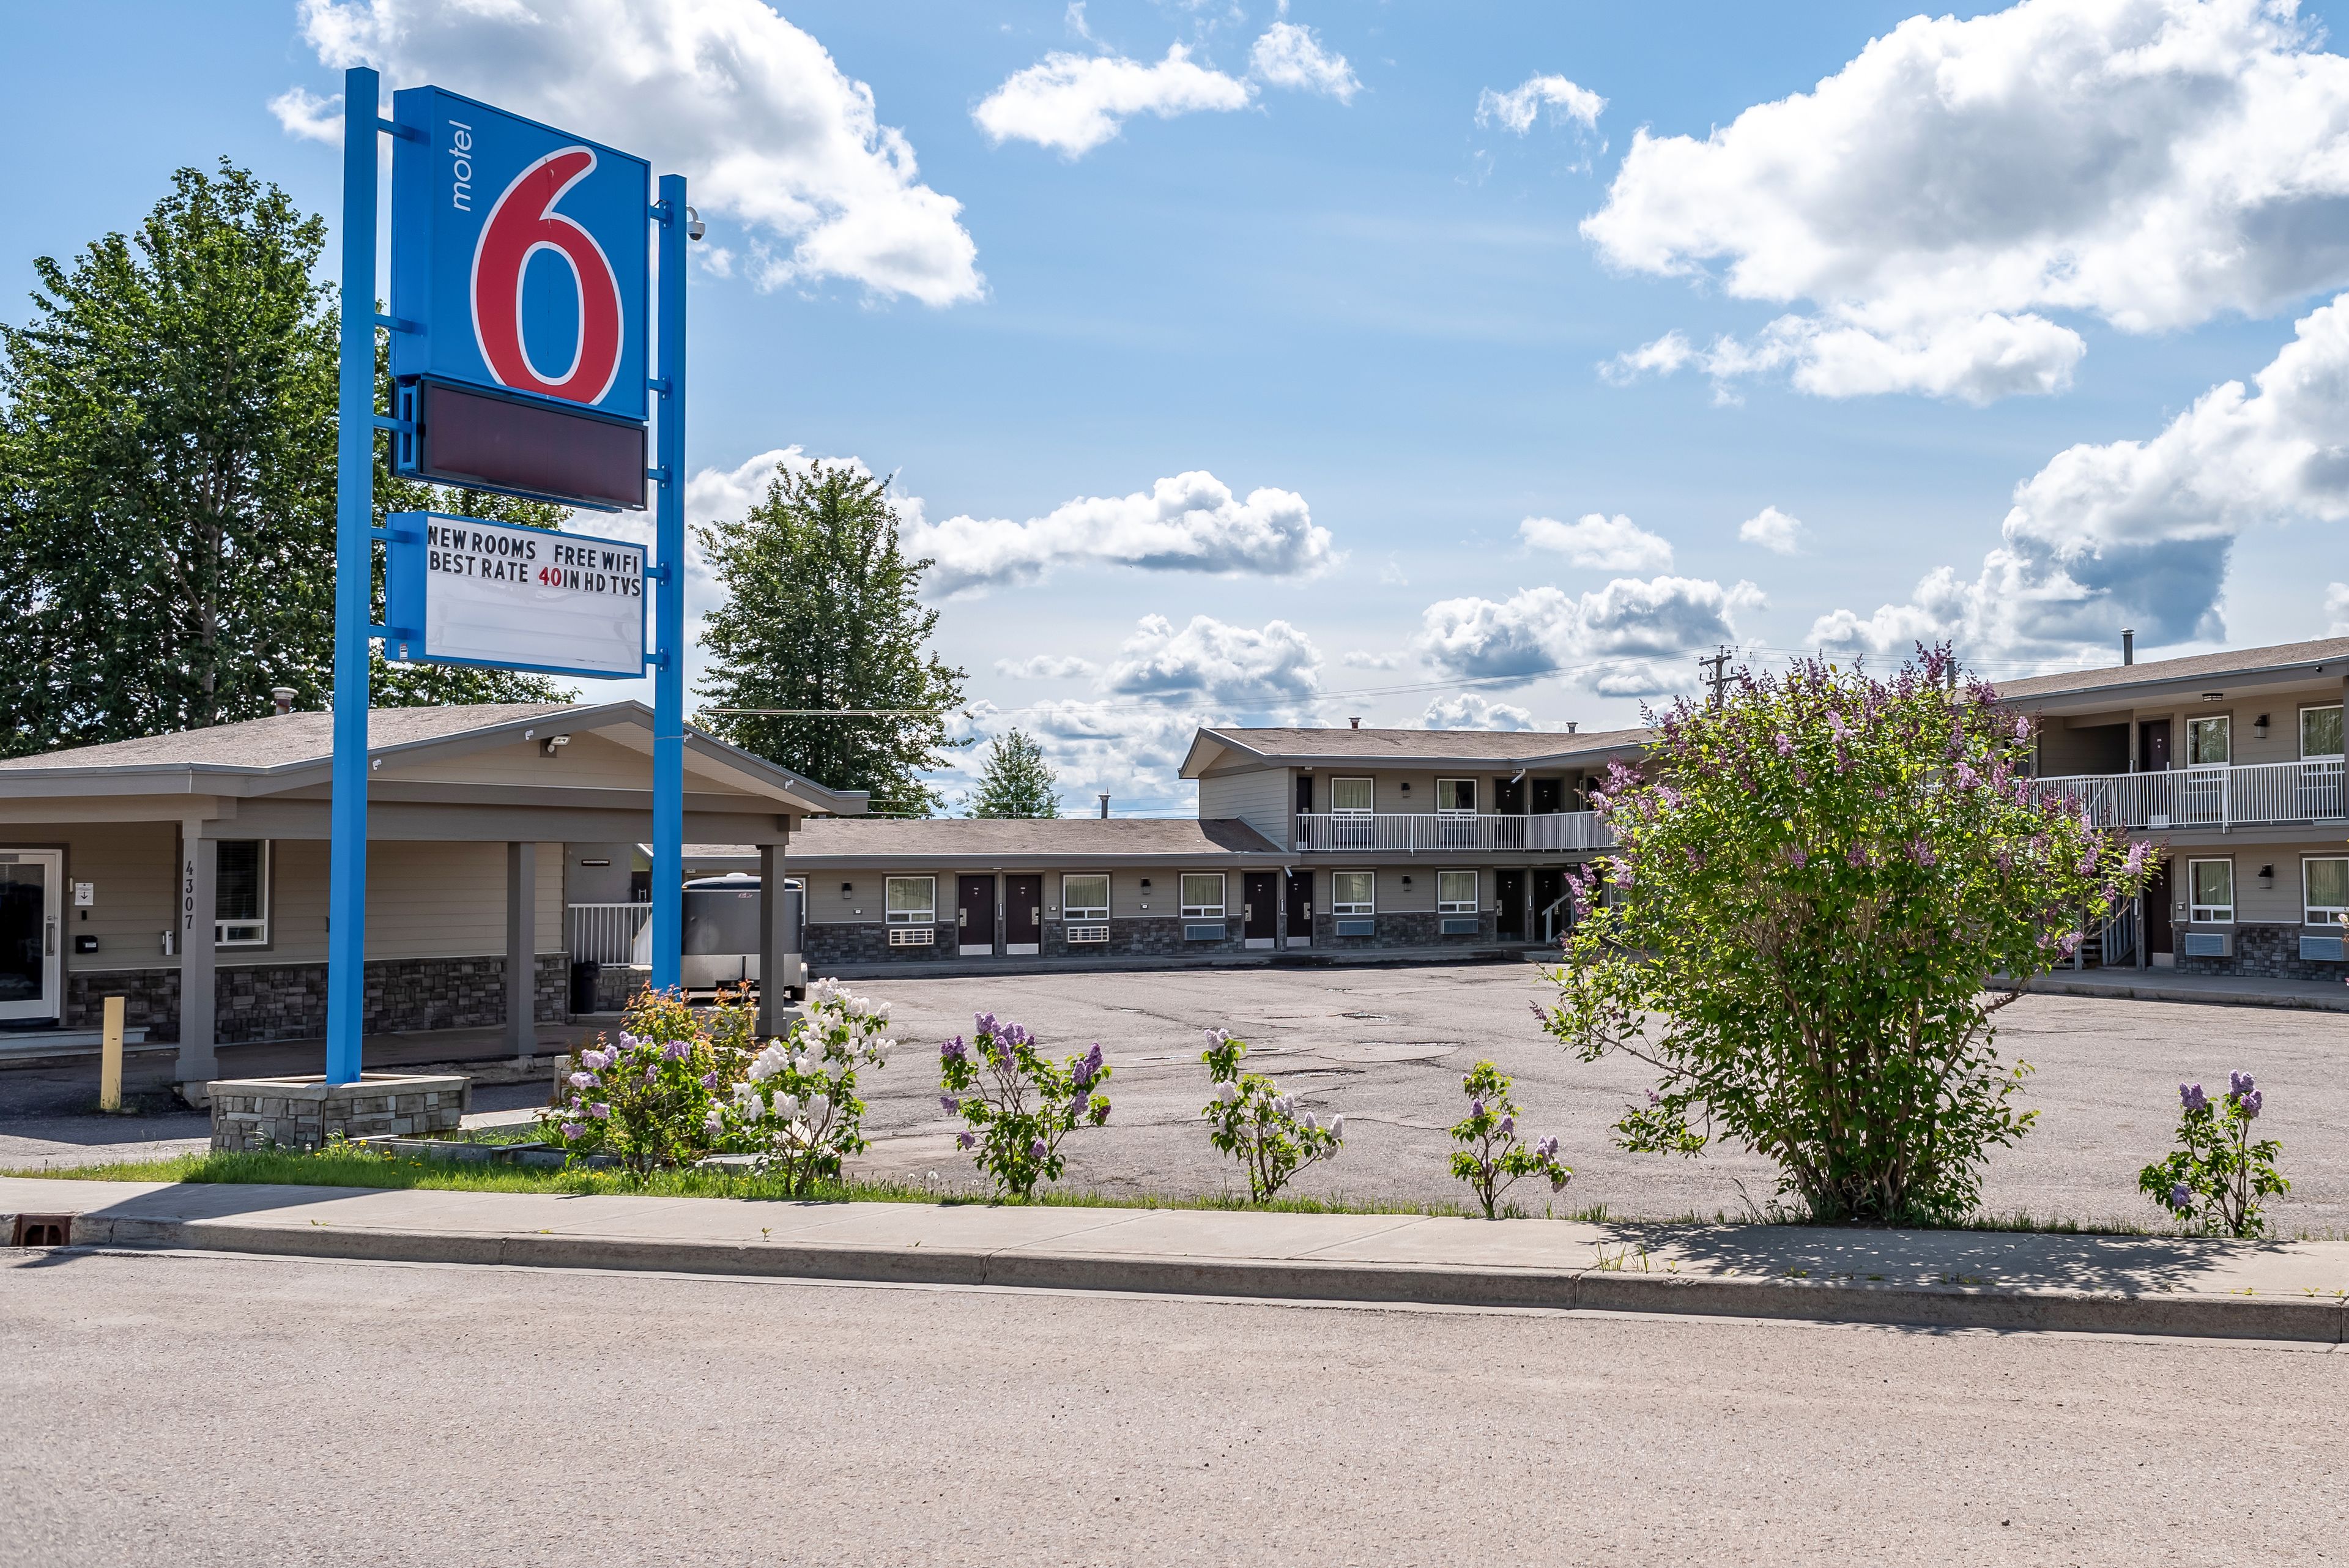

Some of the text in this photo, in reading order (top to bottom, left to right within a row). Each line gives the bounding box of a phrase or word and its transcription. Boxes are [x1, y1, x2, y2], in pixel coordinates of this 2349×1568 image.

[448, 119, 472, 212] motel
[470, 145, 624, 406] 6
[428, 525, 637, 574] NEW ROOMS FREE WIFI
[429, 551, 476, 575] BEST
[481, 557, 529, 582] RATE
[584, 572, 606, 592] HD
[610, 575, 640, 597] TVS
[185, 860, 194, 930] 4307
